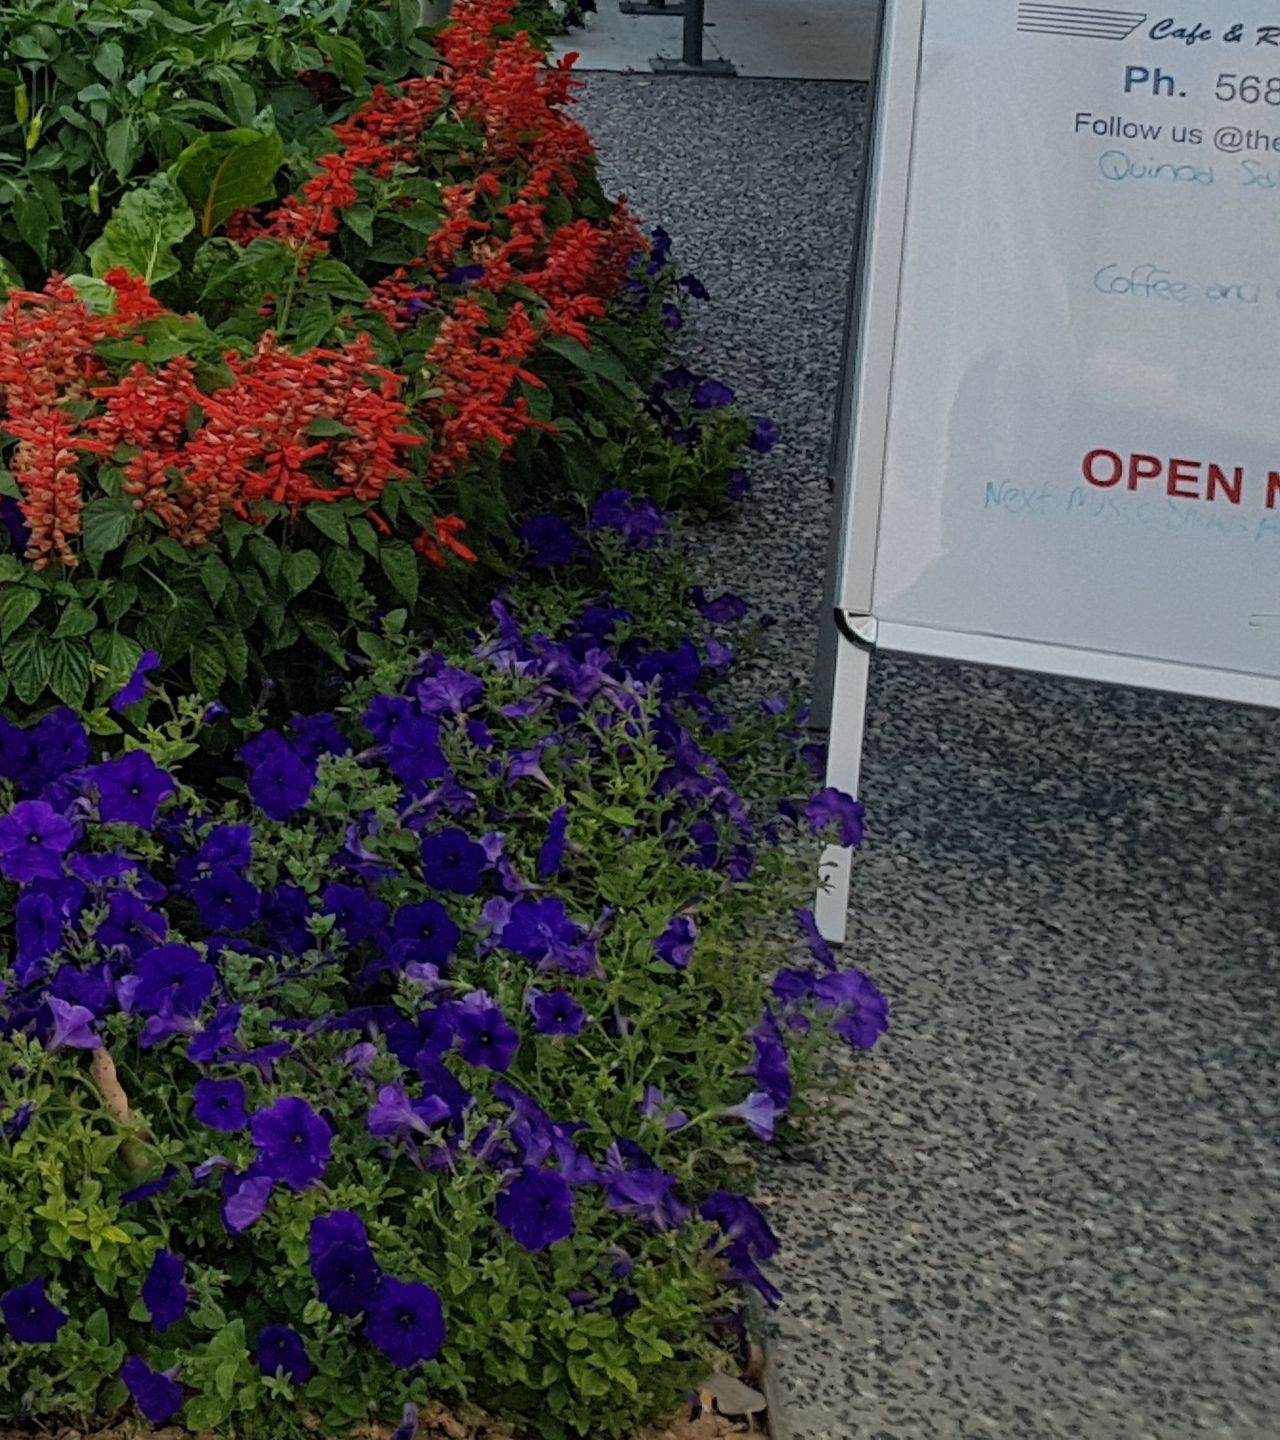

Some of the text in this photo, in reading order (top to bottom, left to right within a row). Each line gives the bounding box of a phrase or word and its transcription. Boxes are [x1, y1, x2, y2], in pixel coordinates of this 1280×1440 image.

[1149, 18, 1280, 47] Cafe & R
[1124, 65, 1280, 107] Ph. 568
[1075, 112, 1280, 154] Follow us @the
[1094, 263, 1187, 301] Coffee
[1082, 448, 1244, 505] OPEN
